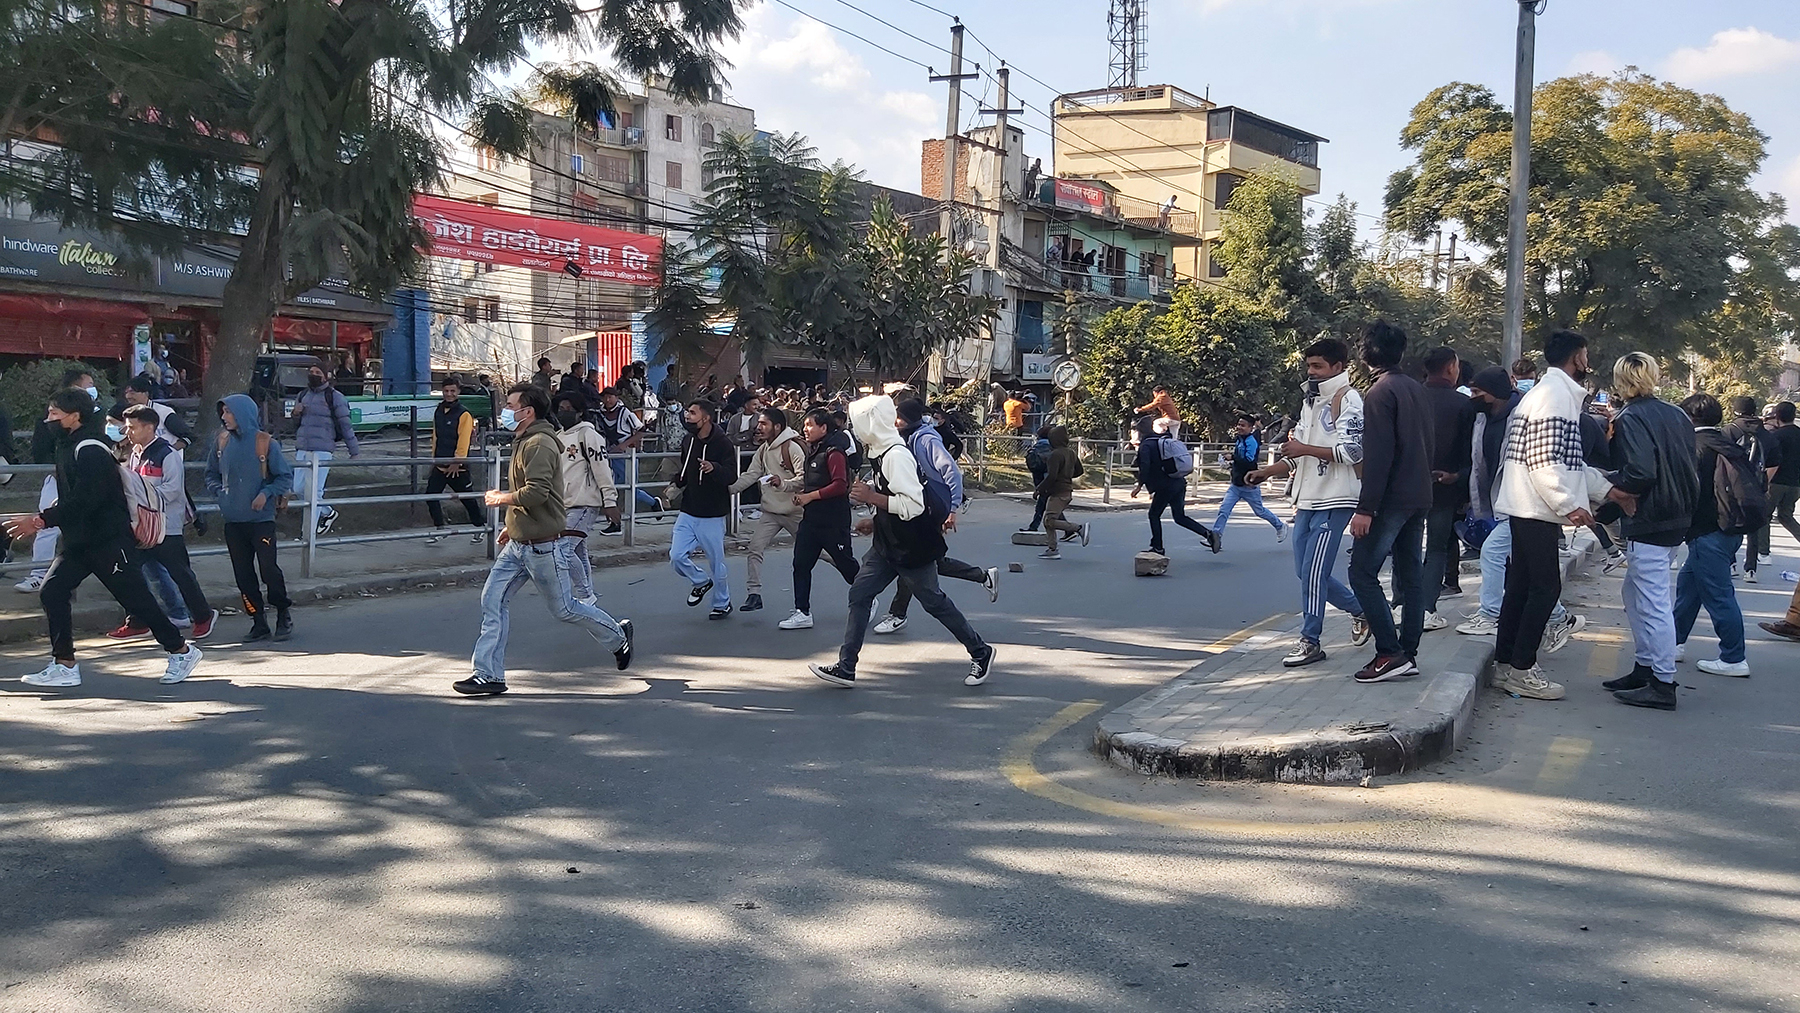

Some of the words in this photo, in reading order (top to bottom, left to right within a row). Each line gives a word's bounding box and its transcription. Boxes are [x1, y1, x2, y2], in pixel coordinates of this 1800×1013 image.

[3, 236, 59, 254] hindware
[59, 240, 119, 267] italian
[174, 262, 193, 275] M/S
